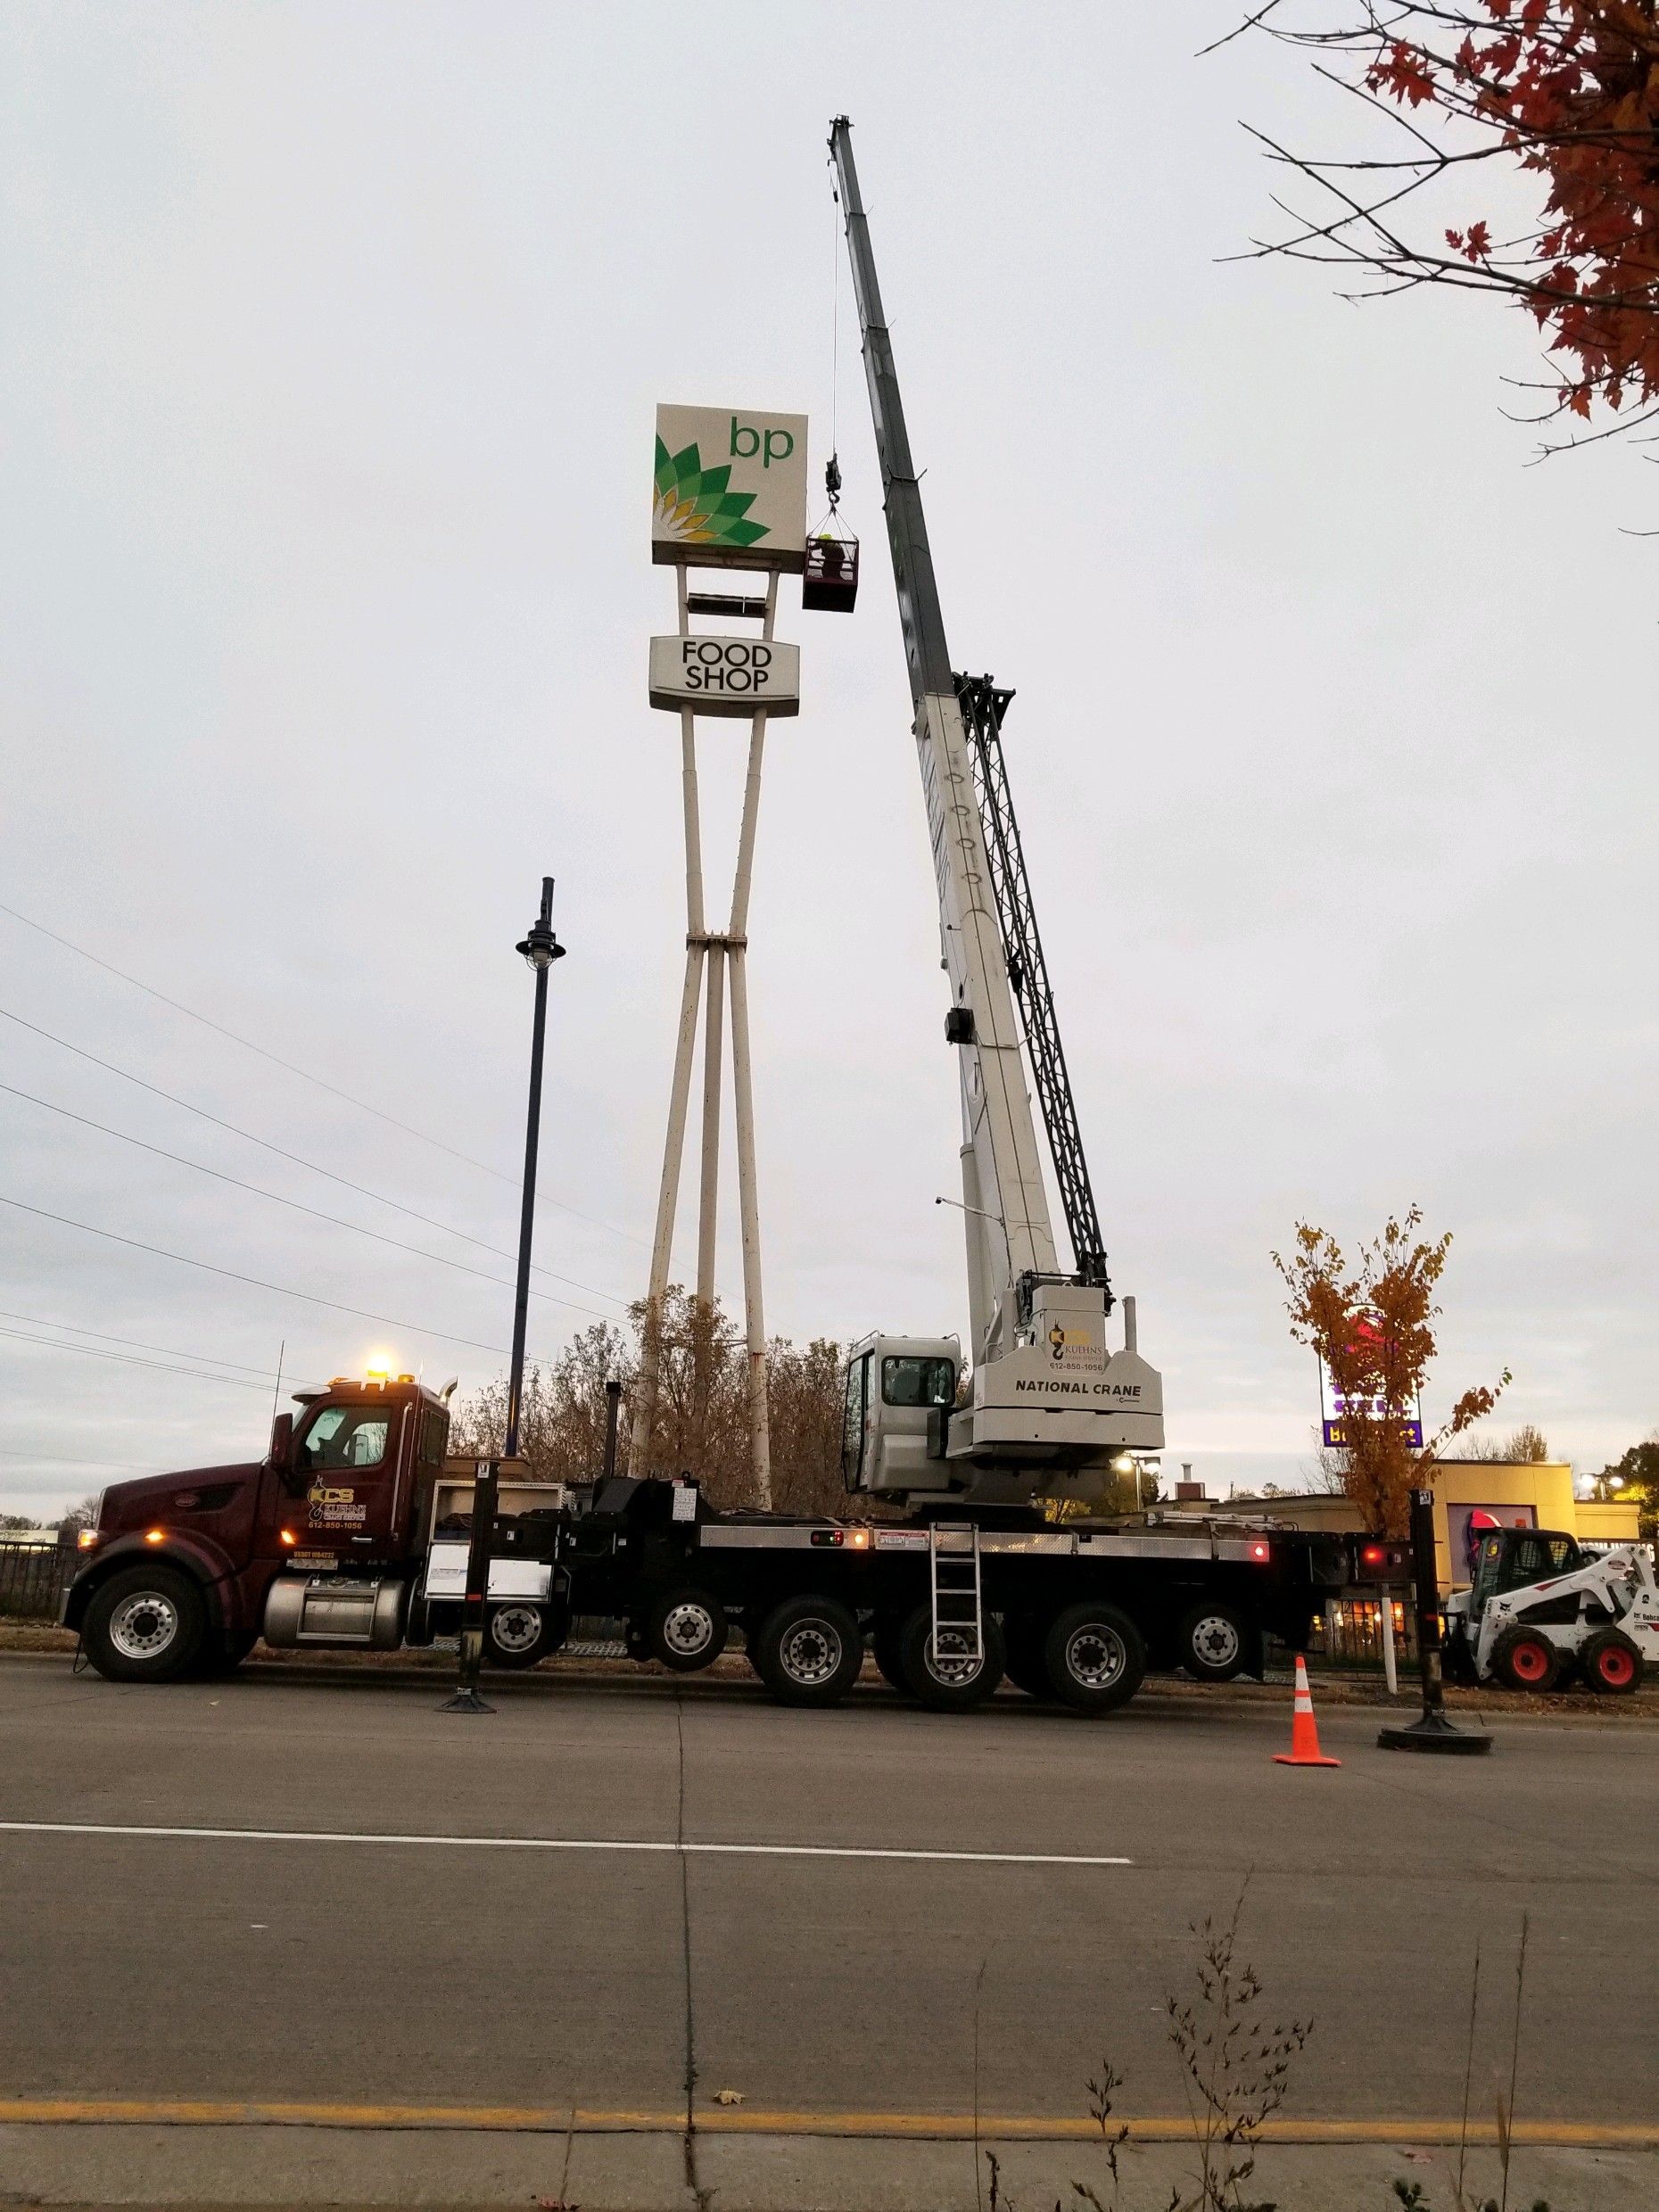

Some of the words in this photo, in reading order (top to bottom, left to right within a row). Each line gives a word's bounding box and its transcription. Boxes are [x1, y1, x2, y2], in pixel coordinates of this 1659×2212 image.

[730, 417, 794, 468] bp
[682, 641, 772, 667] FOOD
[685, 665, 769, 692] SHOP
[1065, 1345, 1102, 1355] KUEHNS
[1049, 1362, 1103, 1371] 612-850-1056
[1015, 1380, 1089, 1394] NATIONAL
[1093, 1383, 1142, 1397] CRANE
[308, 1521, 362, 1530] 612-850-1056
